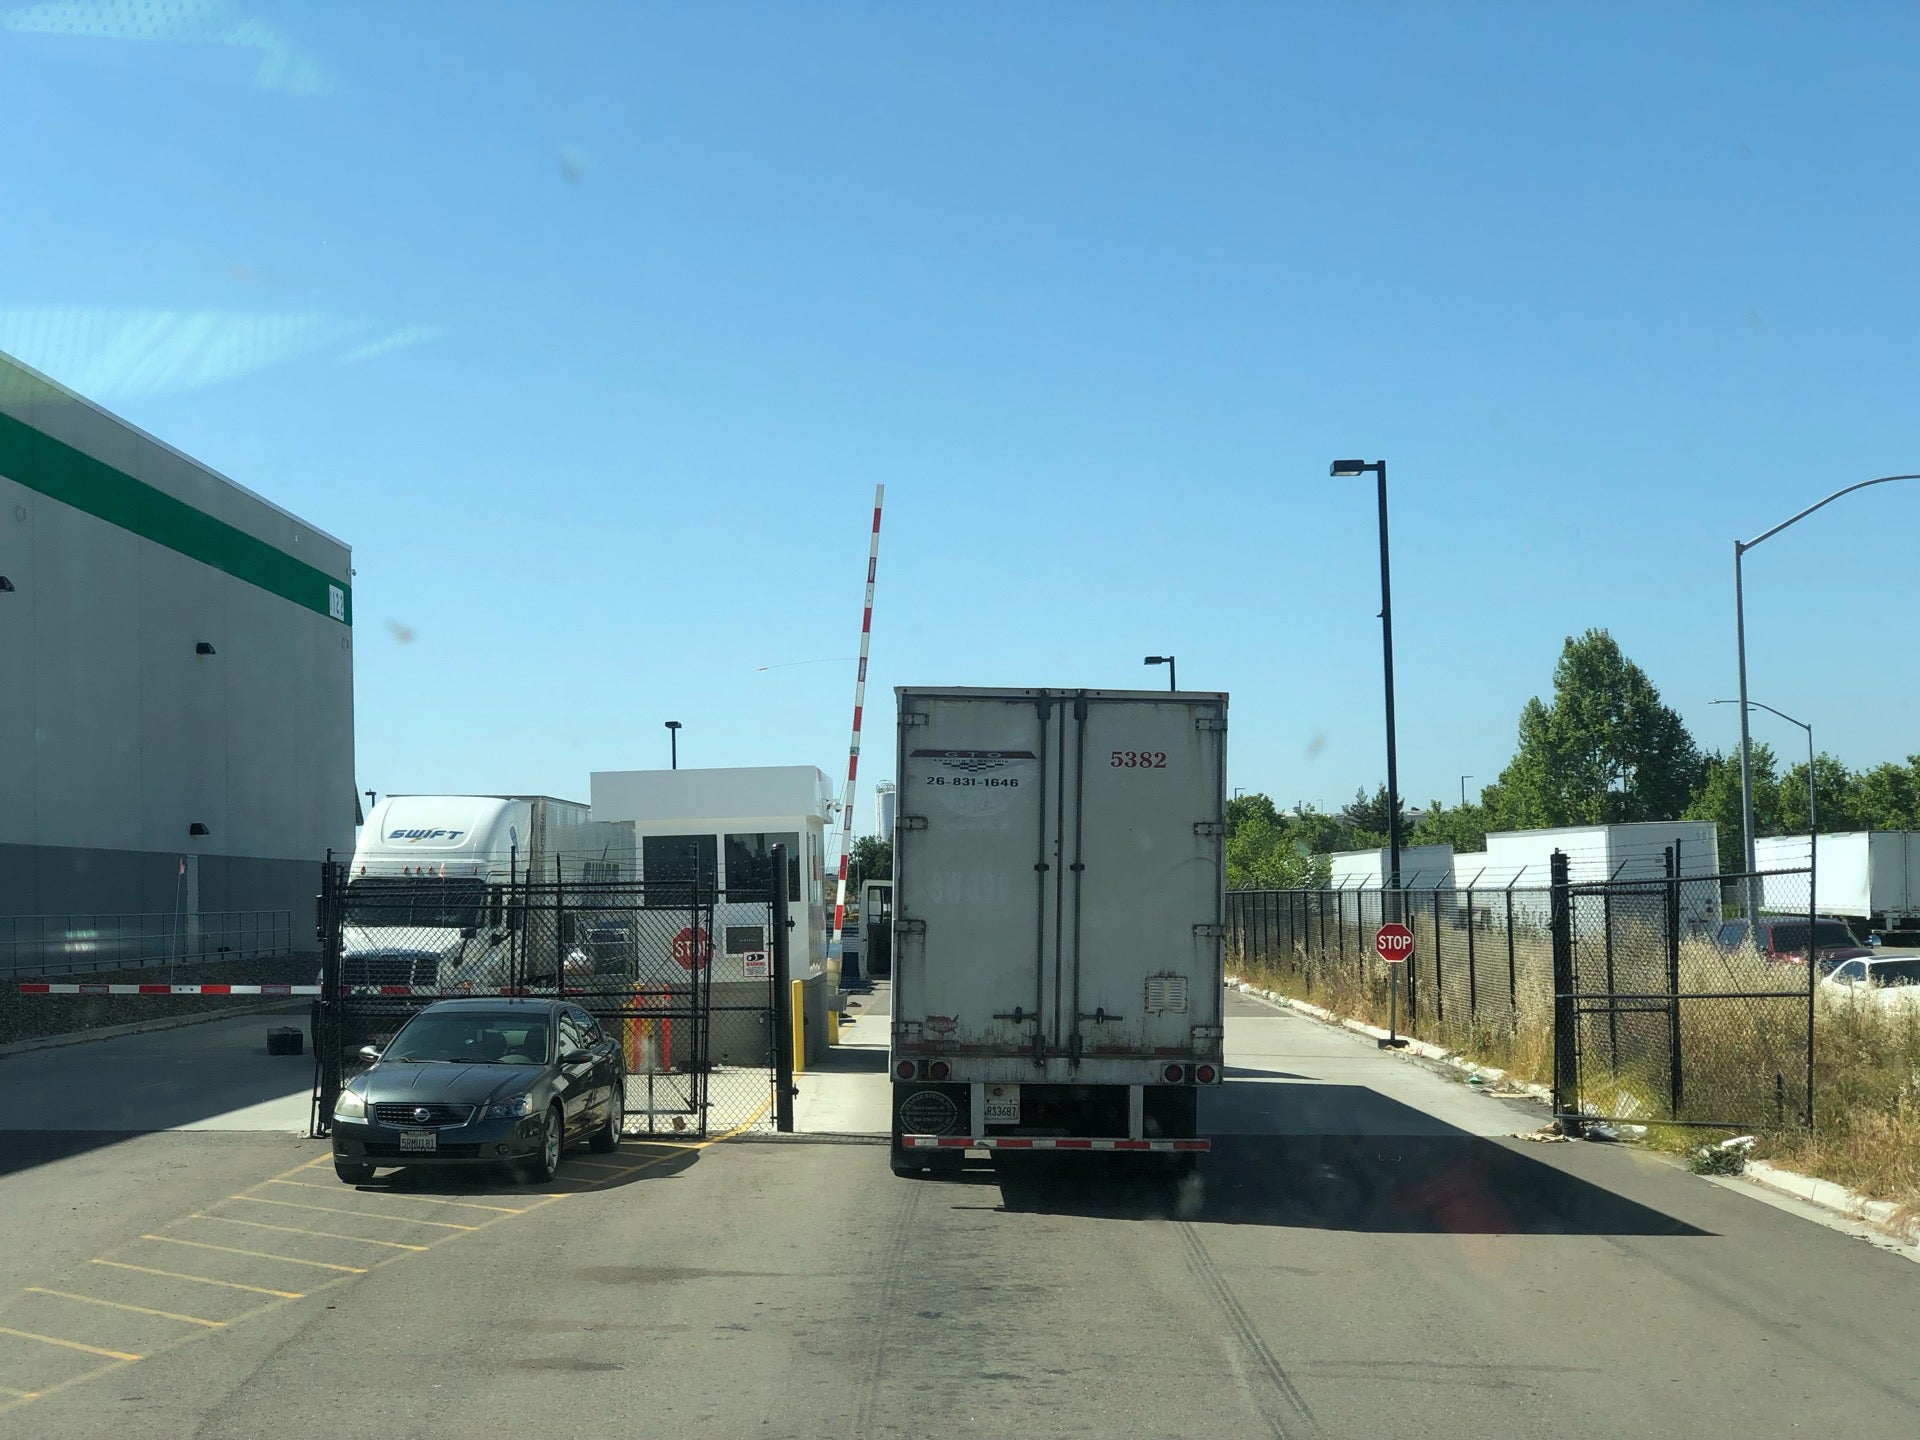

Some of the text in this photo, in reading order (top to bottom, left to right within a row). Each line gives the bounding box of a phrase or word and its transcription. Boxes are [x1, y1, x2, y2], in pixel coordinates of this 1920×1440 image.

[1110, 751, 1167, 768] 5382
[926, 776, 1019, 788] 26-831-1646
[389, 829, 465, 840] SWIFT
[1378, 935, 1411, 950] STOP
